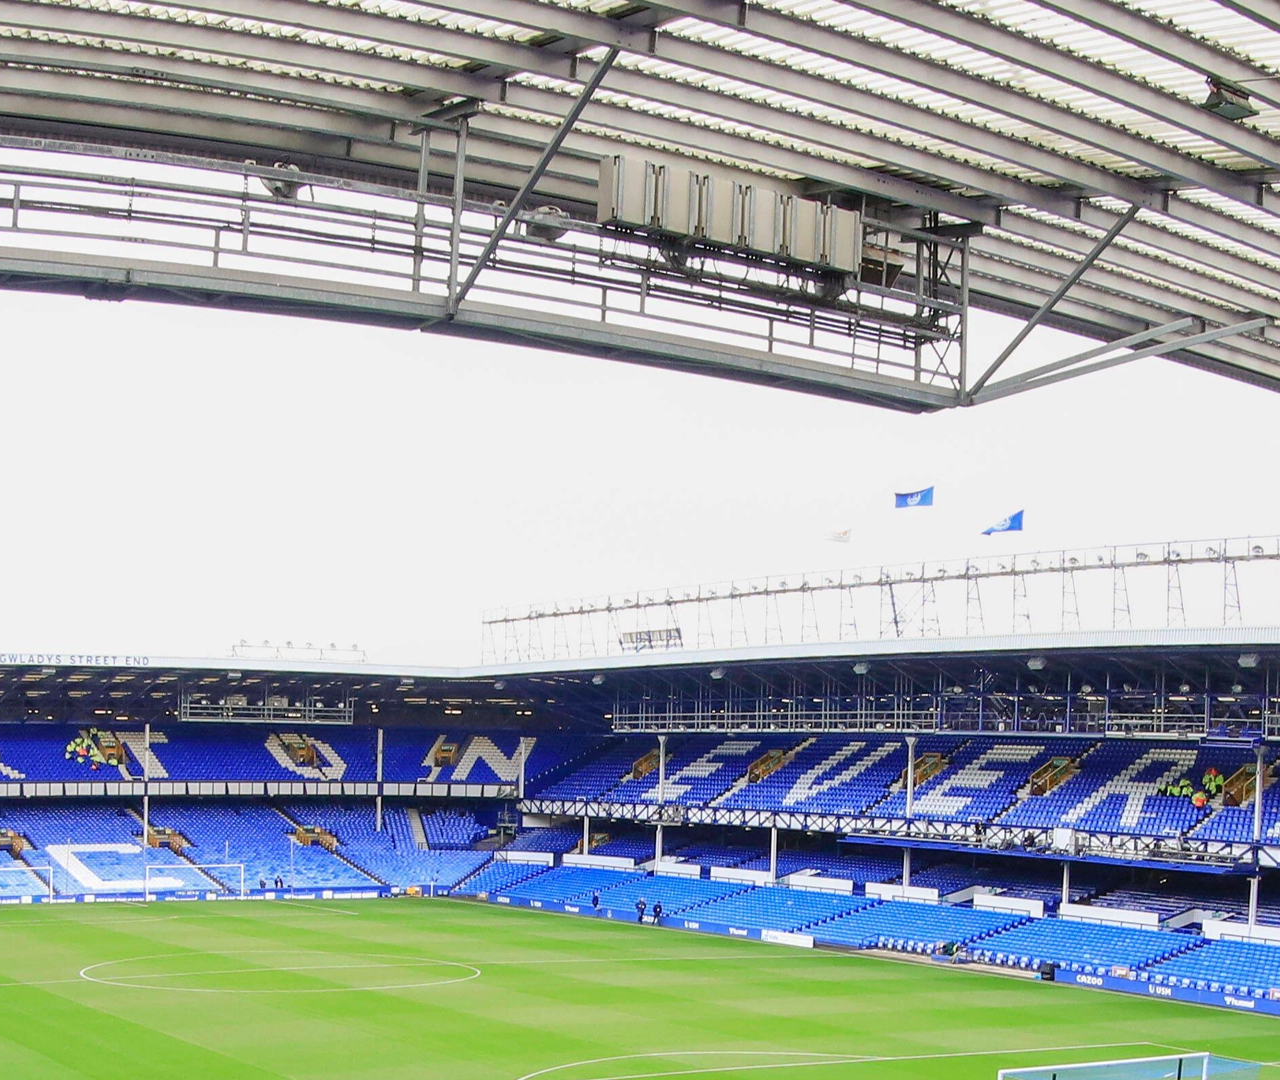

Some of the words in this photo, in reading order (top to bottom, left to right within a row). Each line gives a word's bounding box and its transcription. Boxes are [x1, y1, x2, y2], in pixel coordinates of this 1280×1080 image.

[0, 654, 62, 665] GWLADYS
[69, 655, 118, 666] STREET
[125, 656, 150, 667] END
[1076, 975, 1103, 986] CAZOO
